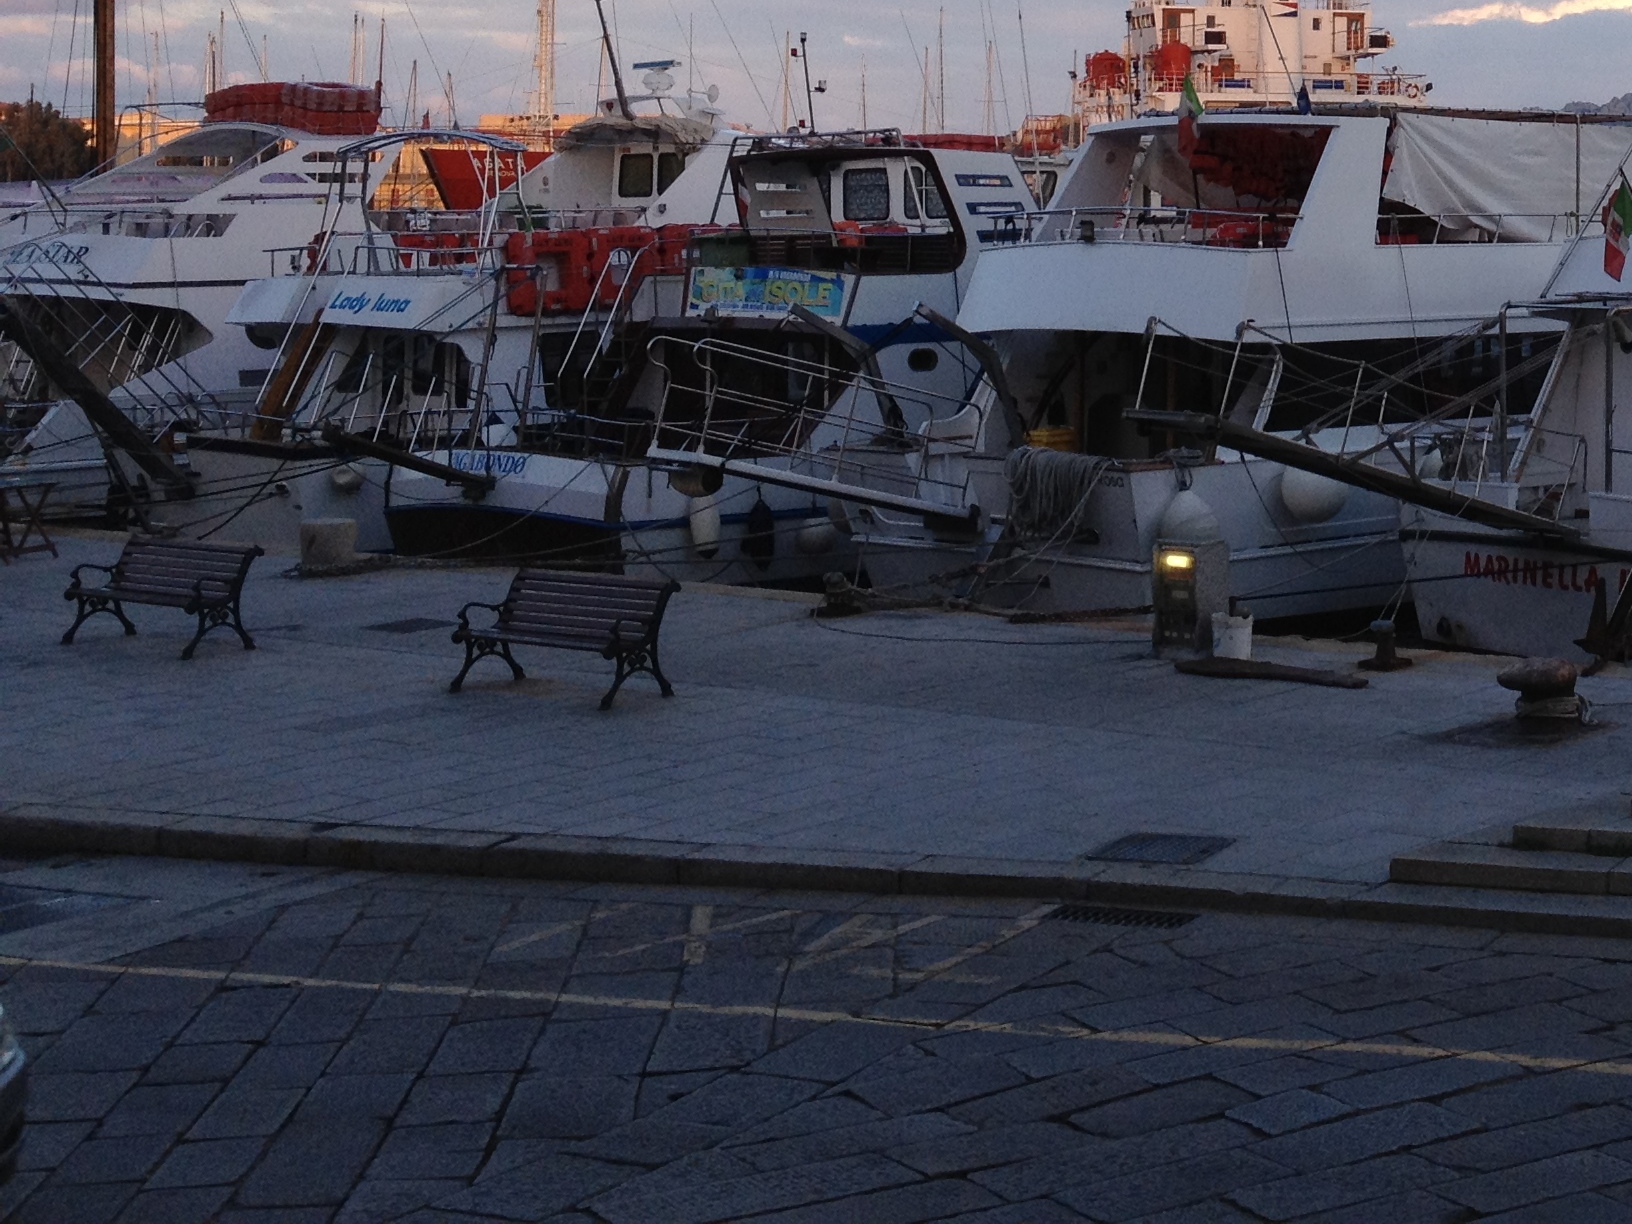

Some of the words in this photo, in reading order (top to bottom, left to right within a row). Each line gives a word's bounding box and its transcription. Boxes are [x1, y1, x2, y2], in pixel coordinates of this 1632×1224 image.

[329, 291, 371, 314] Lady
[371, 292, 411, 313] luna
[1464, 551, 1600, 593] MARINELLA
